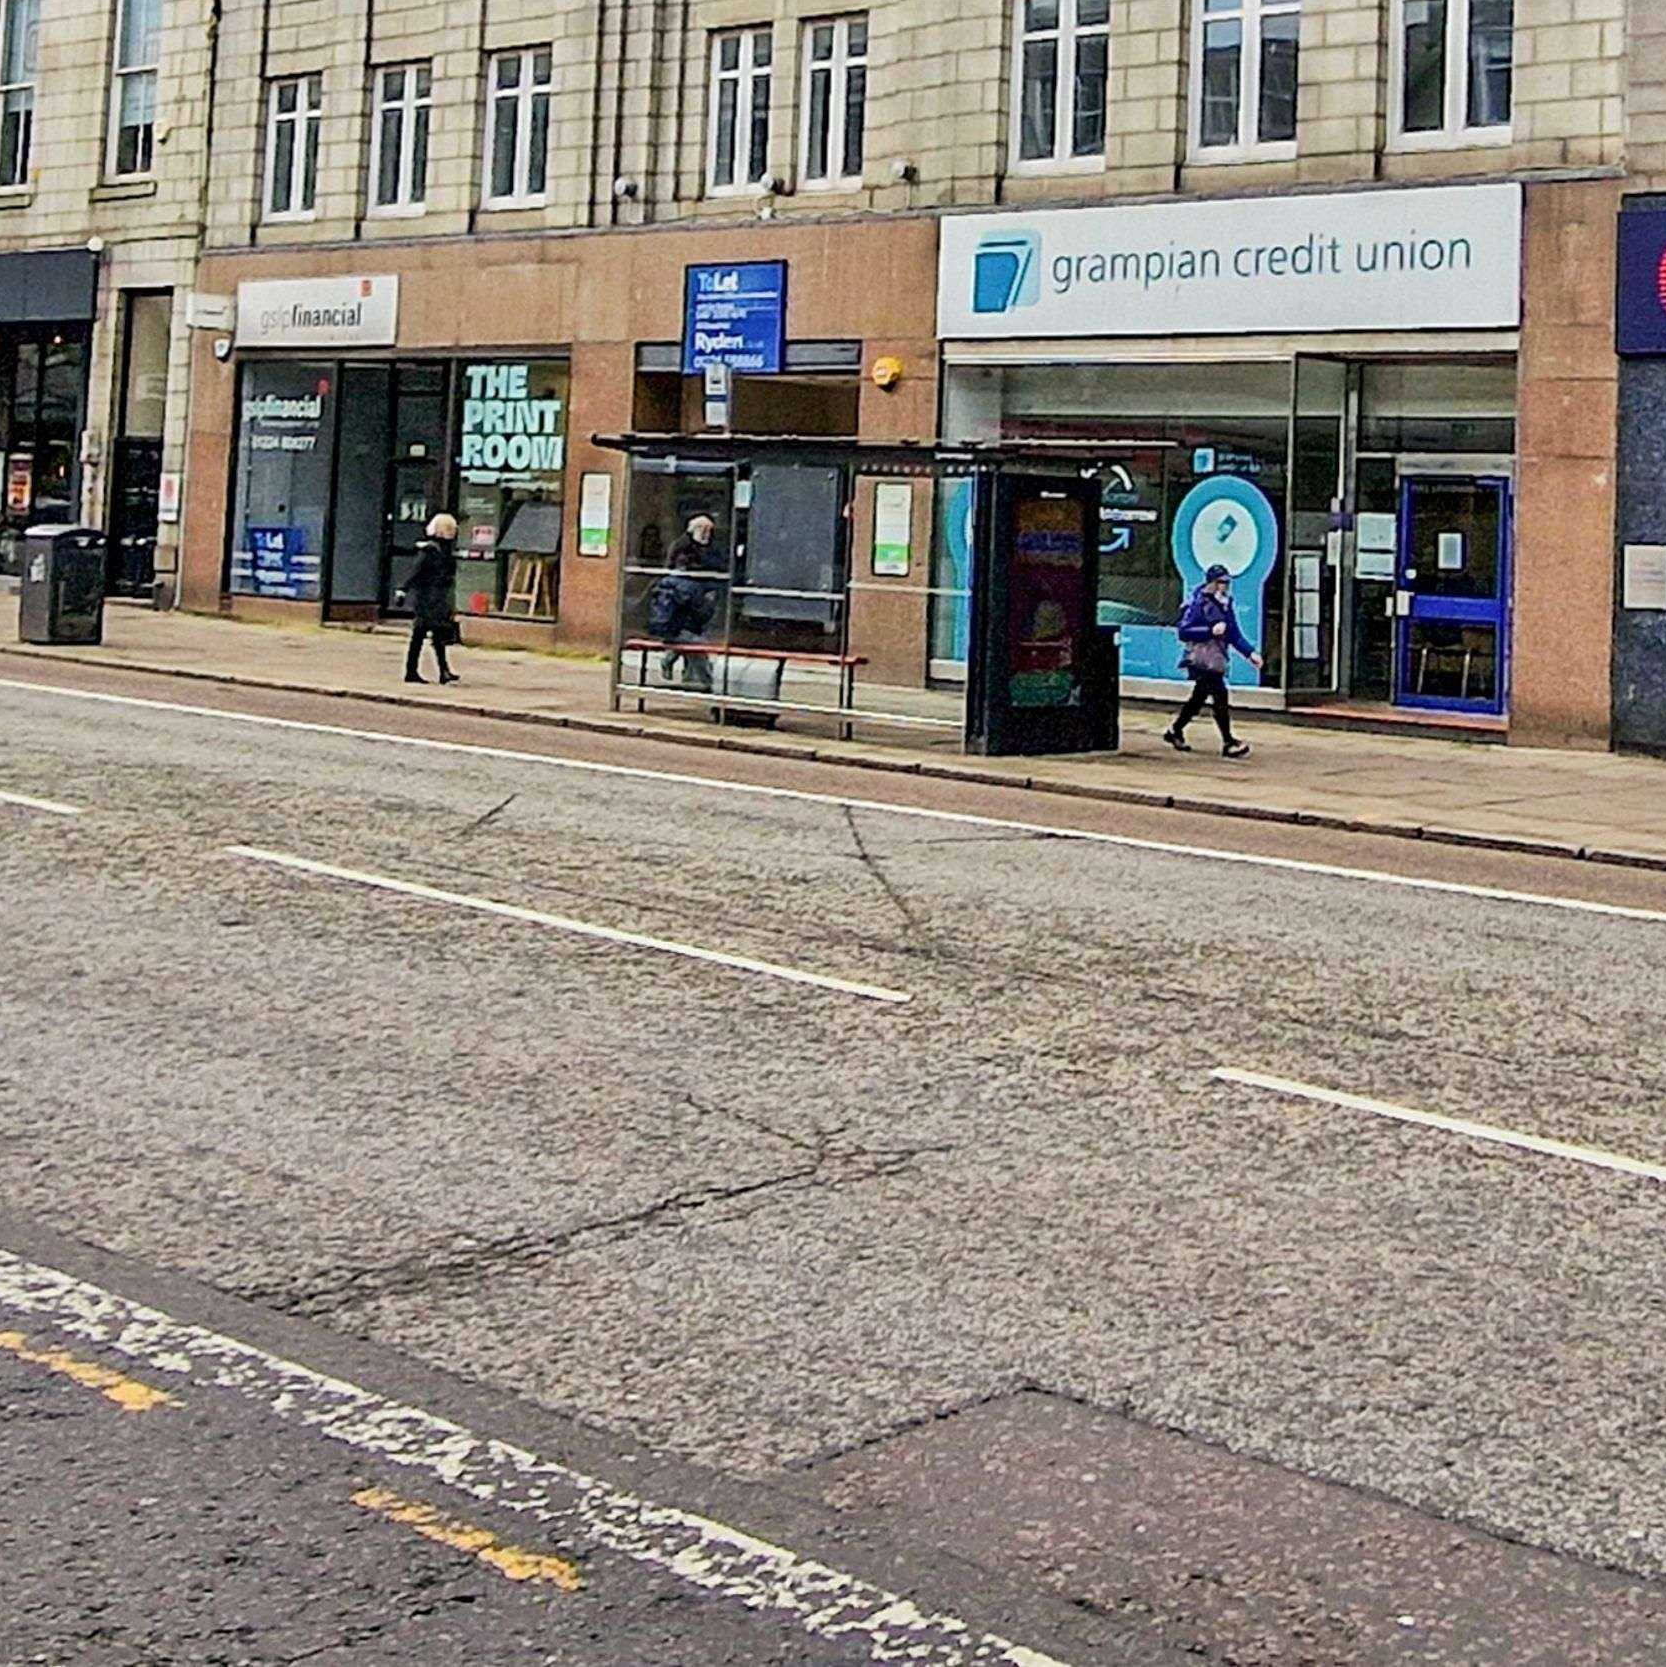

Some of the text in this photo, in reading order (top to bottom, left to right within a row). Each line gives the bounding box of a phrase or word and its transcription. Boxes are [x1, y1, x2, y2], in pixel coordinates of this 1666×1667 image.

[1052, 228, 1472, 294] grampian credit union
[694, 331, 744, 353] Ryden
[466, 365, 528, 399] THE
[462, 400, 562, 434] PRINT
[460, 434, 564, 471] ROOM
